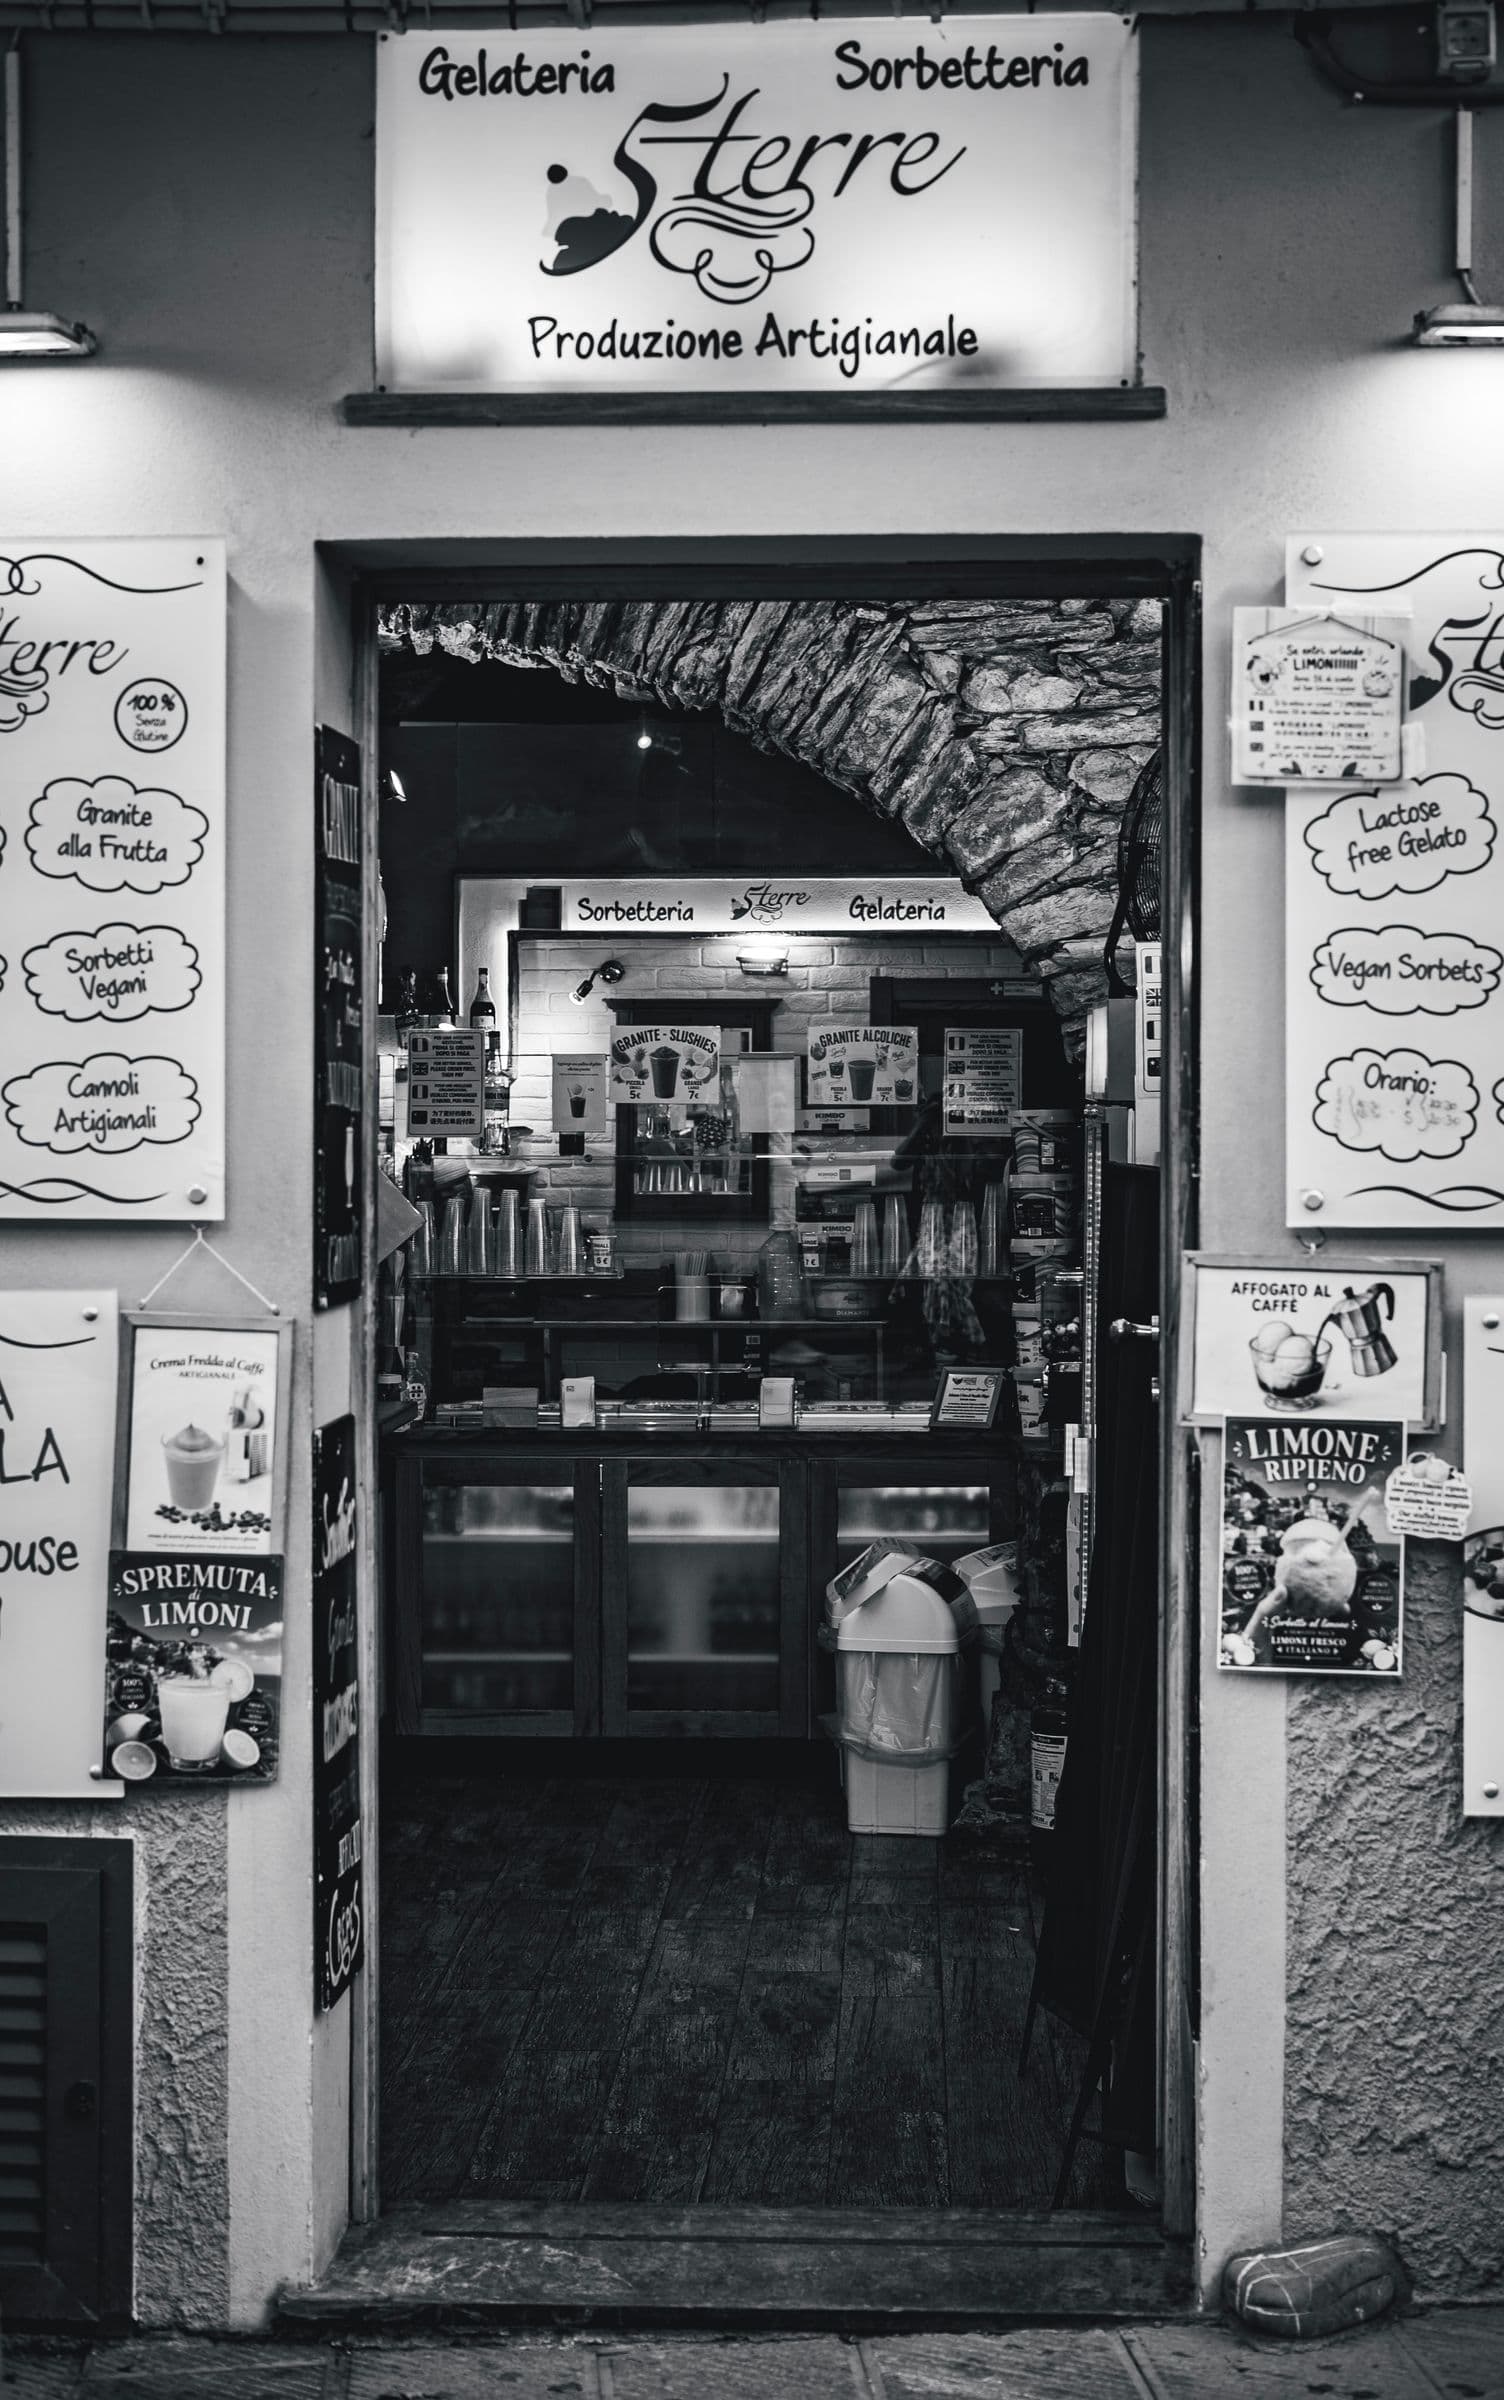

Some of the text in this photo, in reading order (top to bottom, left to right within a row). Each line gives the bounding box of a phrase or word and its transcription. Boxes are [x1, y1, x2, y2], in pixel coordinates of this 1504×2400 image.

[418, 48, 616, 102] Gelateria
[835, 40, 1090, 92] Sorbetteria
[527, 312, 980, 378] Produzione Artigianale
[0, 607, 130, 677] terre
[76, 797, 153, 828] Granite
[1357, 799, 1442, 834] Lactose
[57, 832, 169, 864] alla Frutta
[1347, 825, 1468, 873] free Gelato
[577, 896, 694, 922] Sorbetteria
[848, 895, 946, 922] Gelateria
[64, 940, 154, 974] Sorbetti
[1327, 951, 1485, 990] Vegan Sorbets
[79, 971, 148, 1010] Vegani
[616, 1028, 661, 1052] GRANITE
[669, 1028, 717, 1054] SLUSHIES
[819, 1028, 913, 1049] GRANITE ALCOLICHE
[67, 1073, 140, 1100] Cannoli
[1363, 1062, 1438, 1096] Orario:
[54, 1105, 157, 1144] Artigianali
[1231, 1281, 1332, 1298] AFFOGATO AL
[150, 1357, 186, 1371] Crema
[225, 1356, 237, 1369] al
[1244, 1427, 1381, 1463] LIMONE
[1263, 1458, 1367, 1485] RIPIENO
[121, 1564, 268, 1599] SPREMUTA
[142, 1601, 253, 1631] LIMONI
[1270, 1636, 1347, 1647] LIMONE FRESCO
